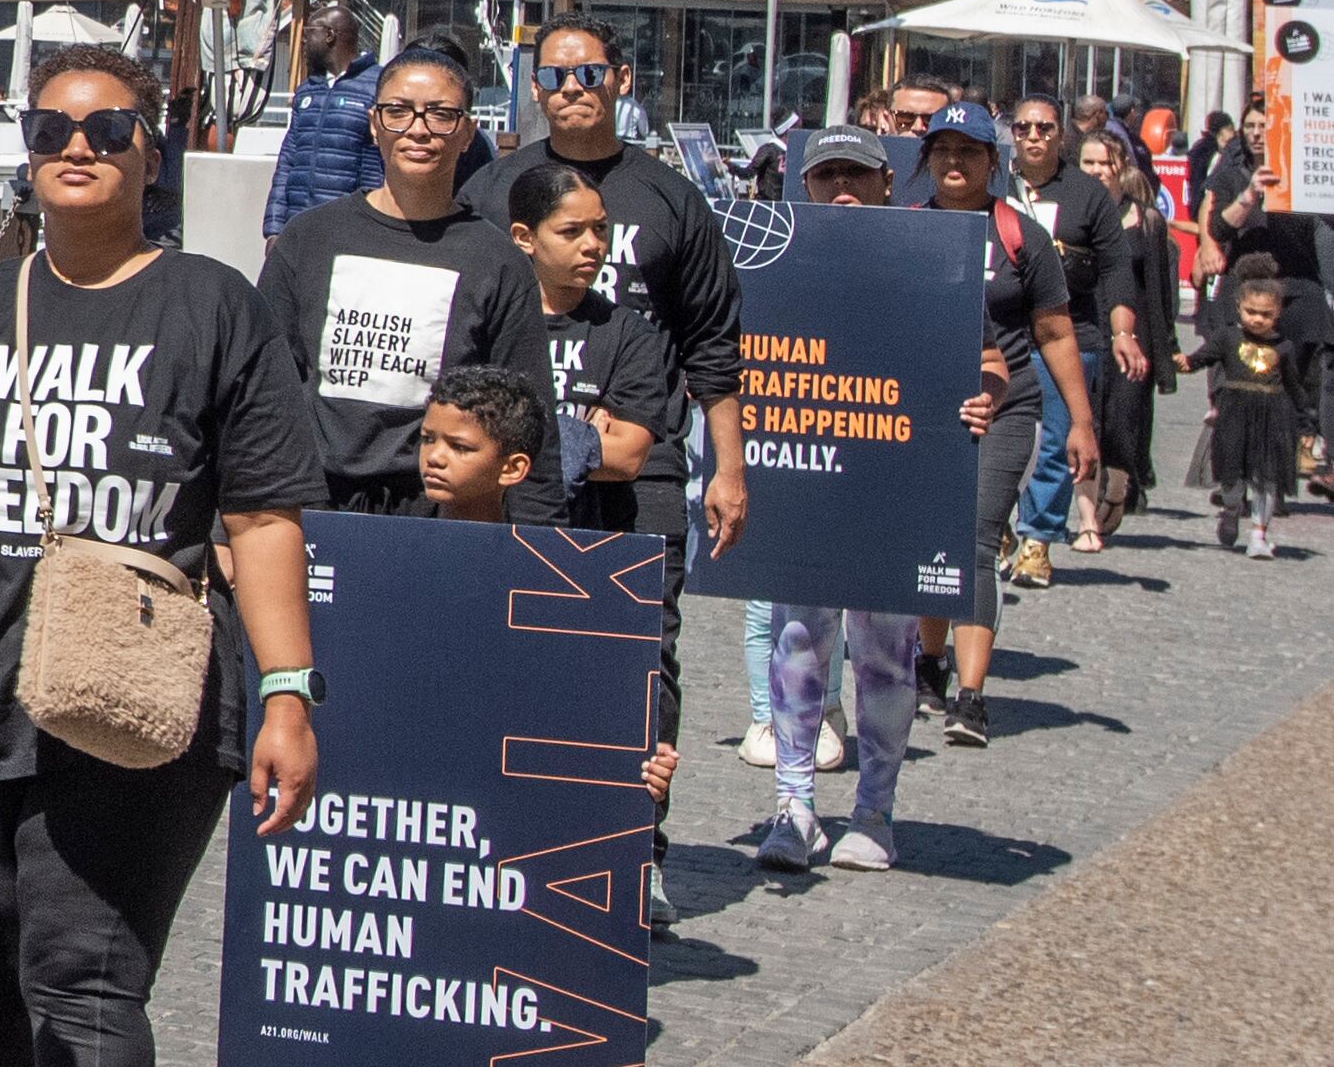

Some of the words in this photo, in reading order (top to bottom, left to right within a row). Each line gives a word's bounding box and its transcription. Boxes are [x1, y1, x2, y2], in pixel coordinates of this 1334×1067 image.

[1312, 93, 1334, 103] WA
[1304, 106, 1330, 117] THE
[818, 133, 862, 146] FREEDOM
[336, 308, 412, 333] ABOLISH
[332, 328, 411, 354] SLAVERY
[739, 333, 827, 365] HUMAN
[330, 347, 376, 369] WITH
[380, 357, 427, 378] EACH
[329, 369, 369, 389] STEP
[2, 402, 113, 470] FOR
[764, 406, 911, 443] HAPPENING
[917, 574, 936, 583] FOR
[918, 564, 944, 575] WALK
[917, 583, 960, 595] FREEDOM
[266, 845, 330, 892] WE
[343, 854, 428, 903] CAN
[443, 864, 527, 912] END
[263, 902, 414, 959] HUMAN
[260, 959, 552, 1033] TRAFFICKING.
[260, 1025, 330, 1045] A21.ORG/WALK
